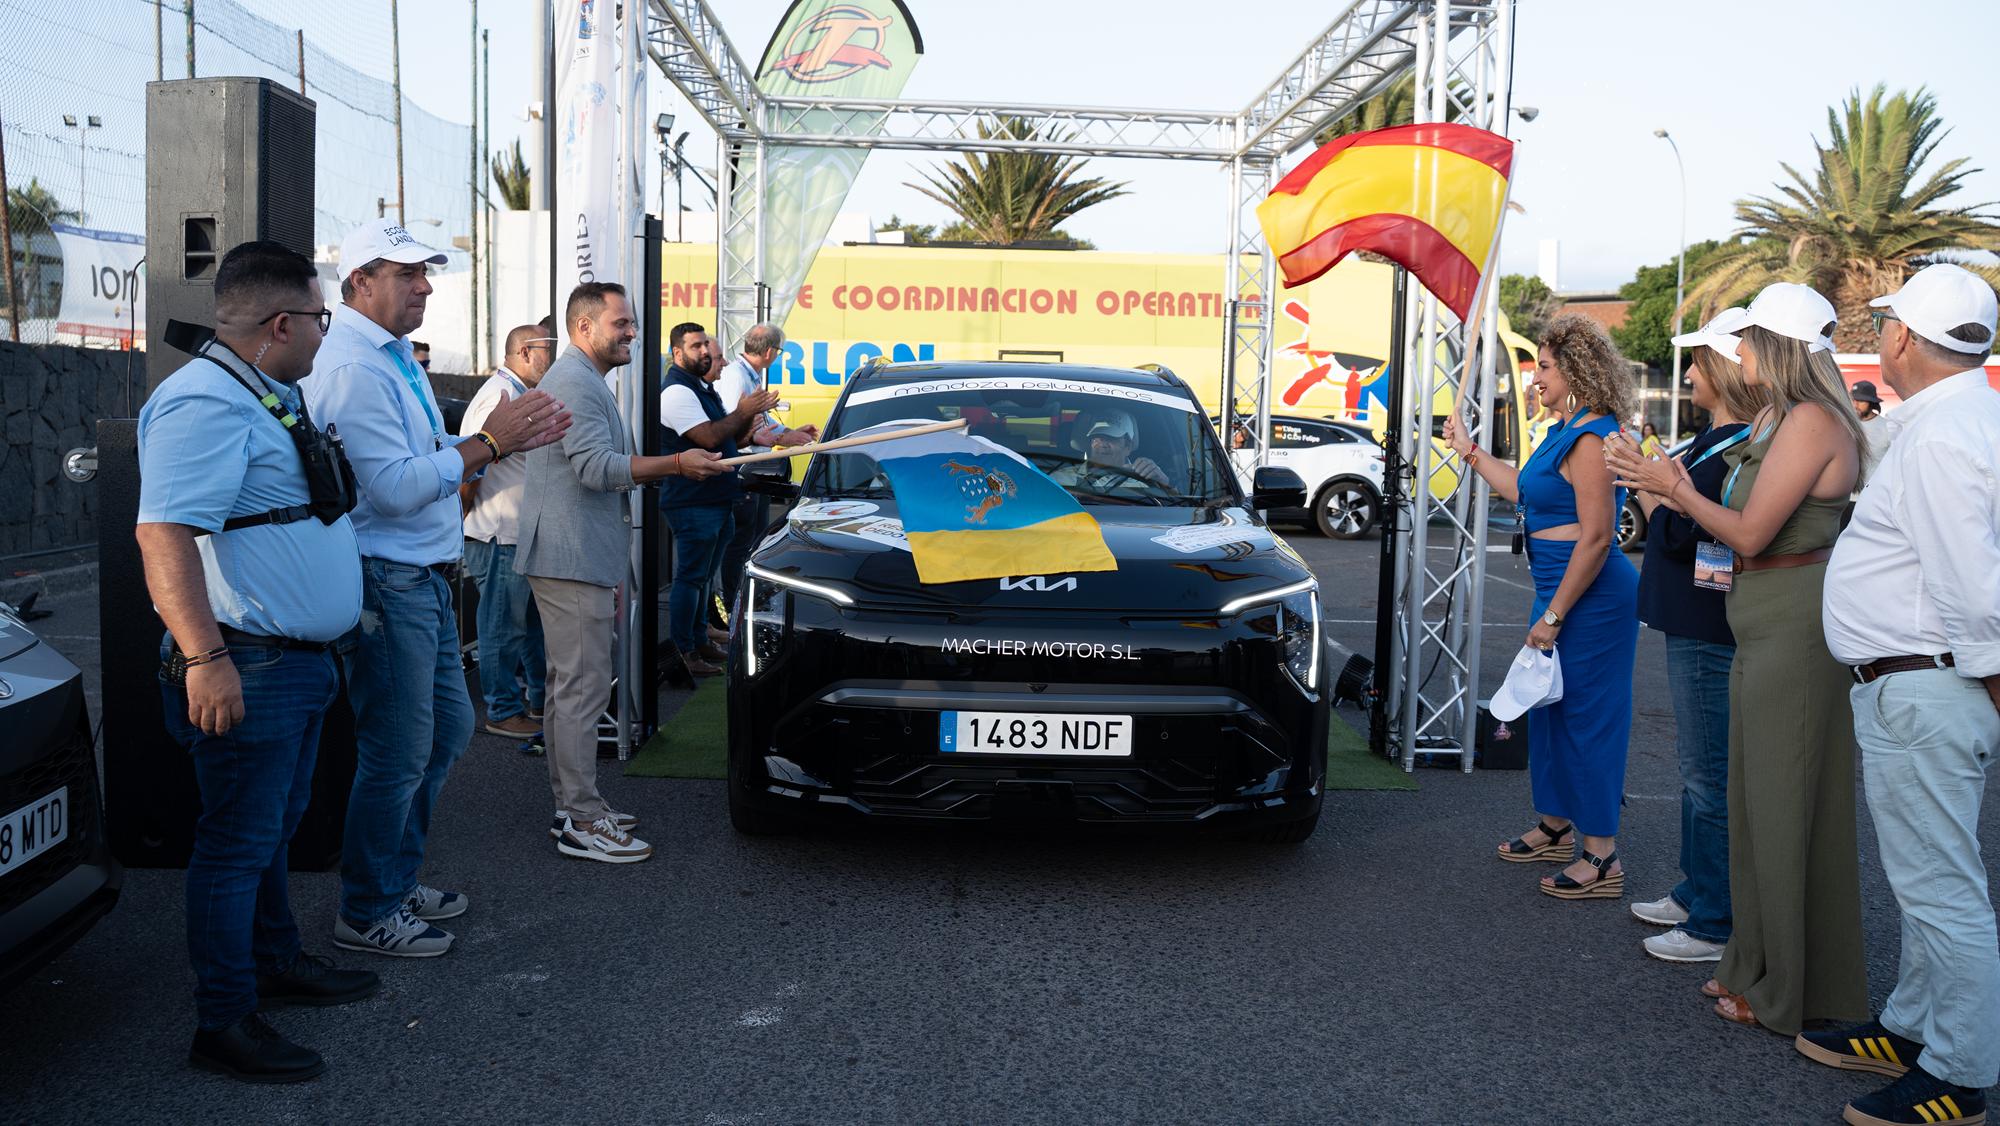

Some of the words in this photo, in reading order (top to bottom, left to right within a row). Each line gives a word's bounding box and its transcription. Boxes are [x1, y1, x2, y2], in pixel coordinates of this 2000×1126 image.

[832, 285, 1077, 314] COORDINACION
[1096, 290, 1262, 318] OPERATIA
[768, 341, 934, 385] RLAN
[894, 380, 1009, 397] mendoza
[1022, 381, 1154, 402] peluqueros
[941, 638, 1026, 656] MACHER
[1031, 641, 1105, 659] MOTOR
[1110, 644, 1142, 660] S.L.
[970, 718, 1048, 749] 1483
[1061, 720, 1123, 750] NDF
[22, 797, 62, 855] MTD
